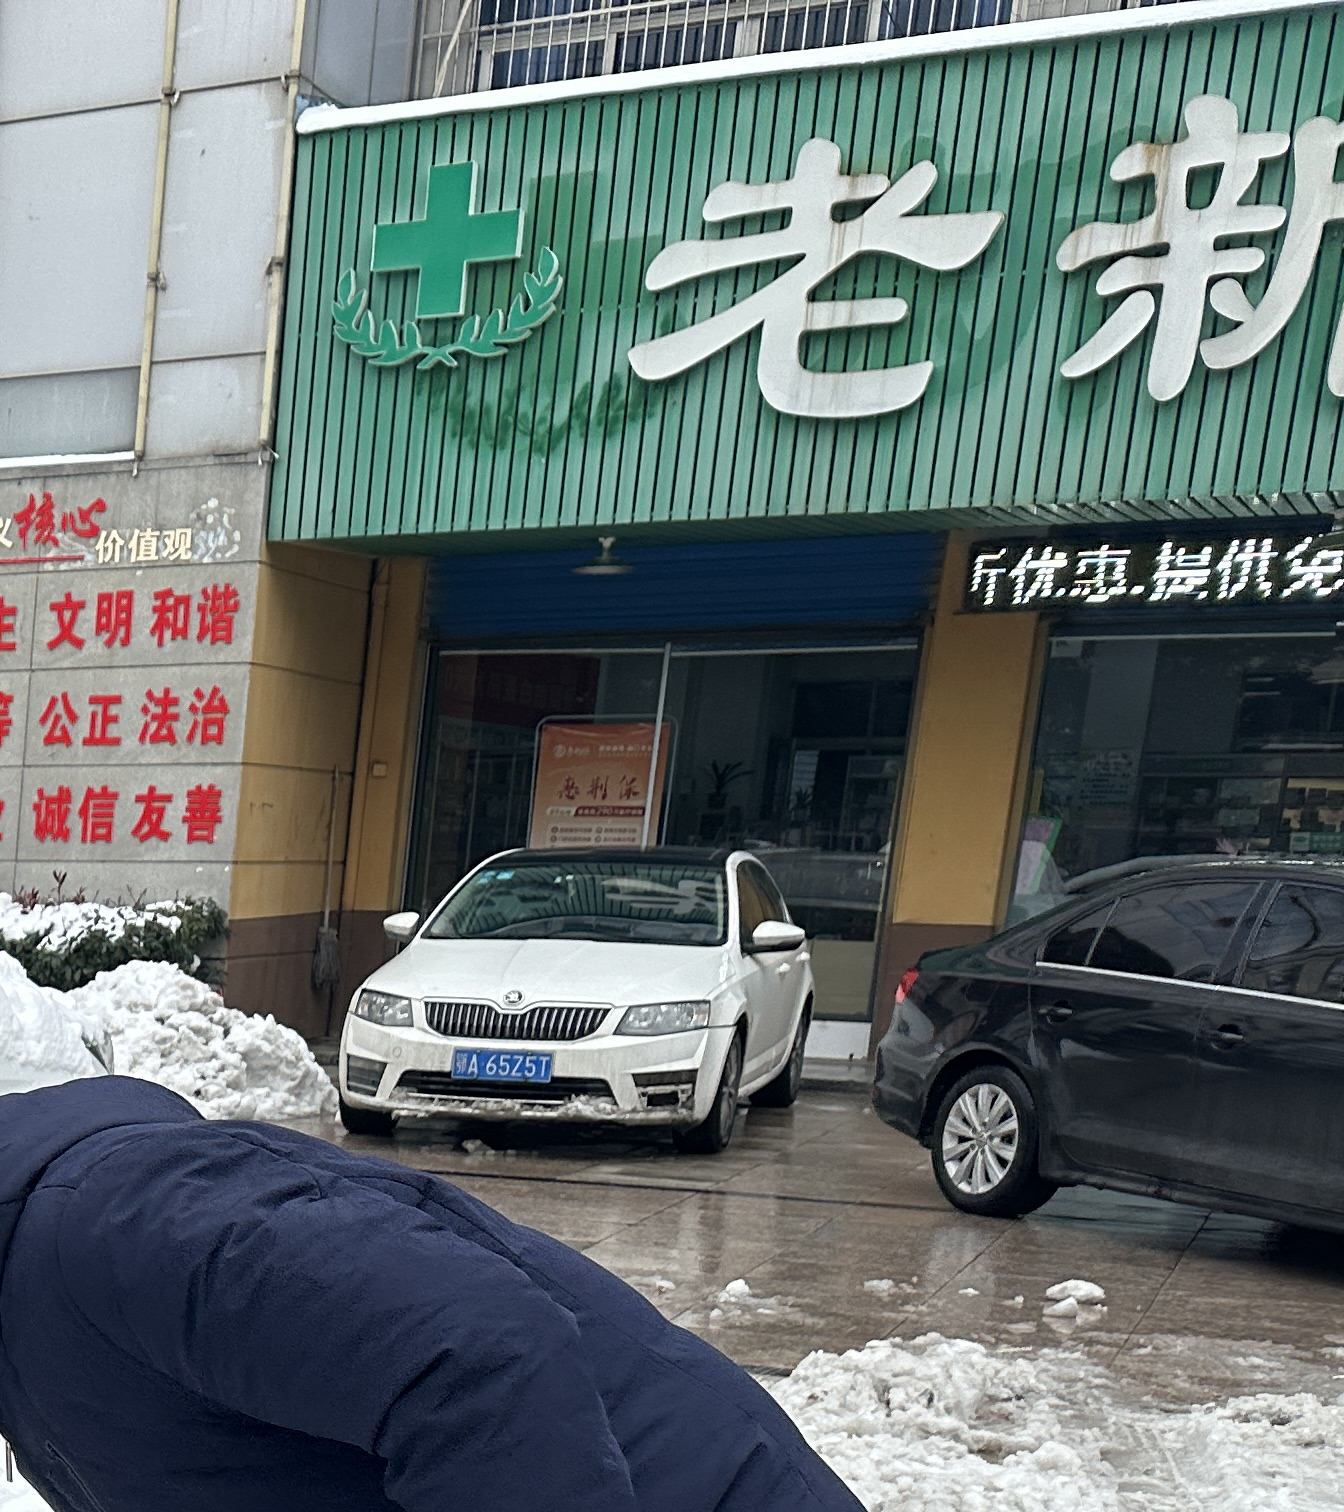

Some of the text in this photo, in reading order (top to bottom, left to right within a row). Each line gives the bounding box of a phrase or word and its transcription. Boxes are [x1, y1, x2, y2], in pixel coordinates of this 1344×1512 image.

[14, 492, 108, 551] 核心
[95, 527, 193, 563] 价值观
